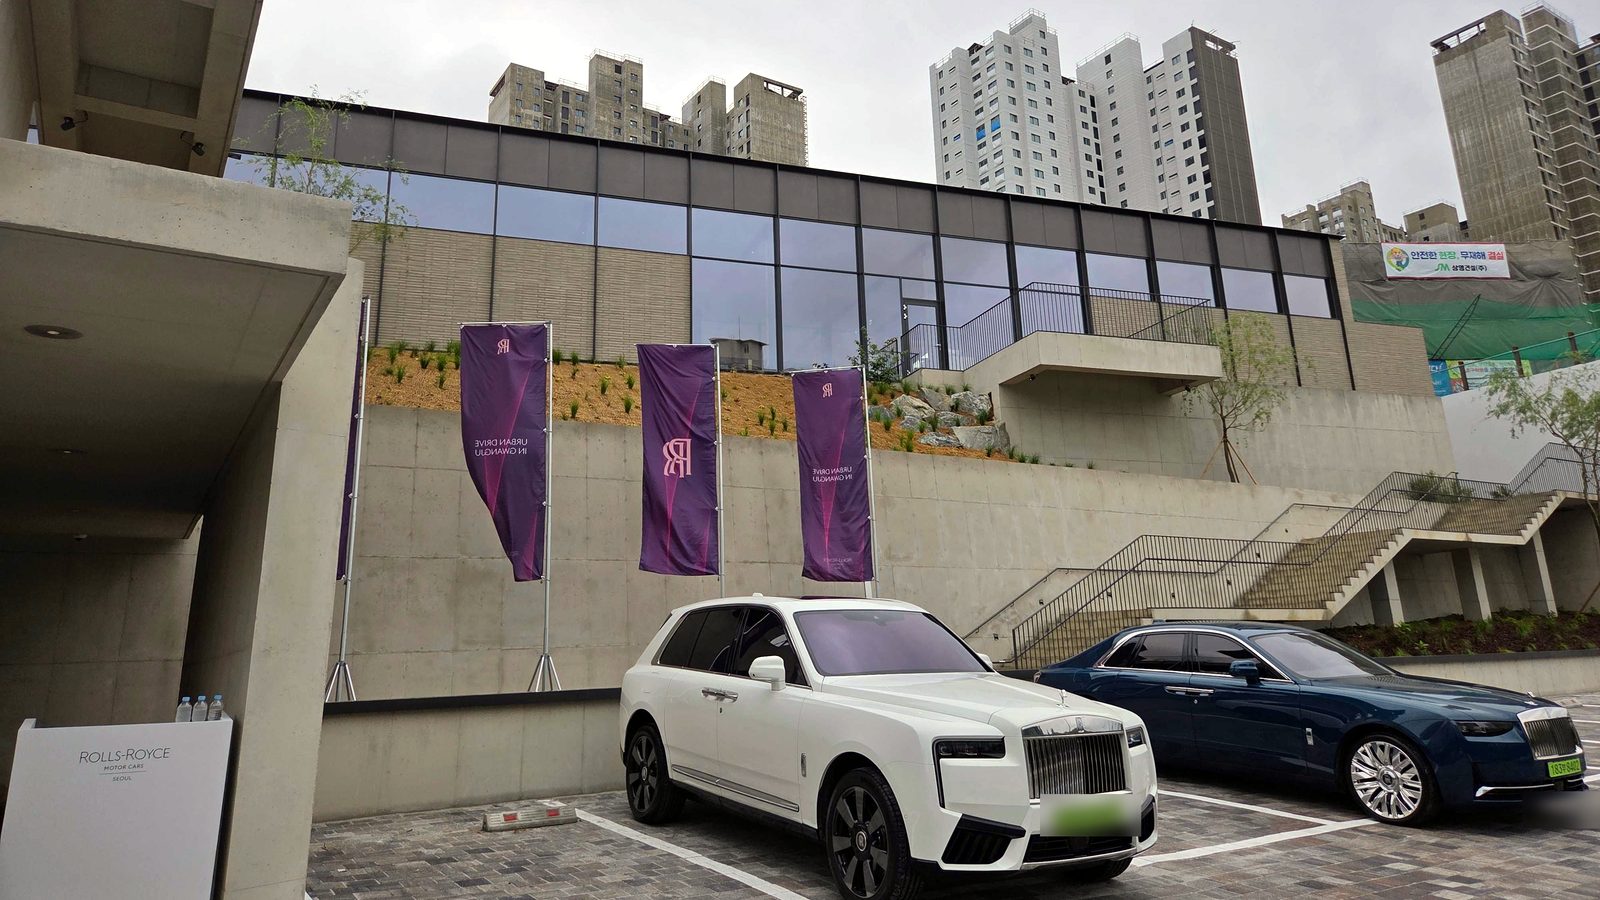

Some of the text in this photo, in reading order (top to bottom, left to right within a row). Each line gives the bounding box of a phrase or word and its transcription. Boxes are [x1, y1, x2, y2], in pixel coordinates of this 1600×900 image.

[1410, 251, 1437, 260] 안전한
[1461, 251, 1486, 260] 무재해
[79, 747, 171, 764] ROLLS-ROYCE
